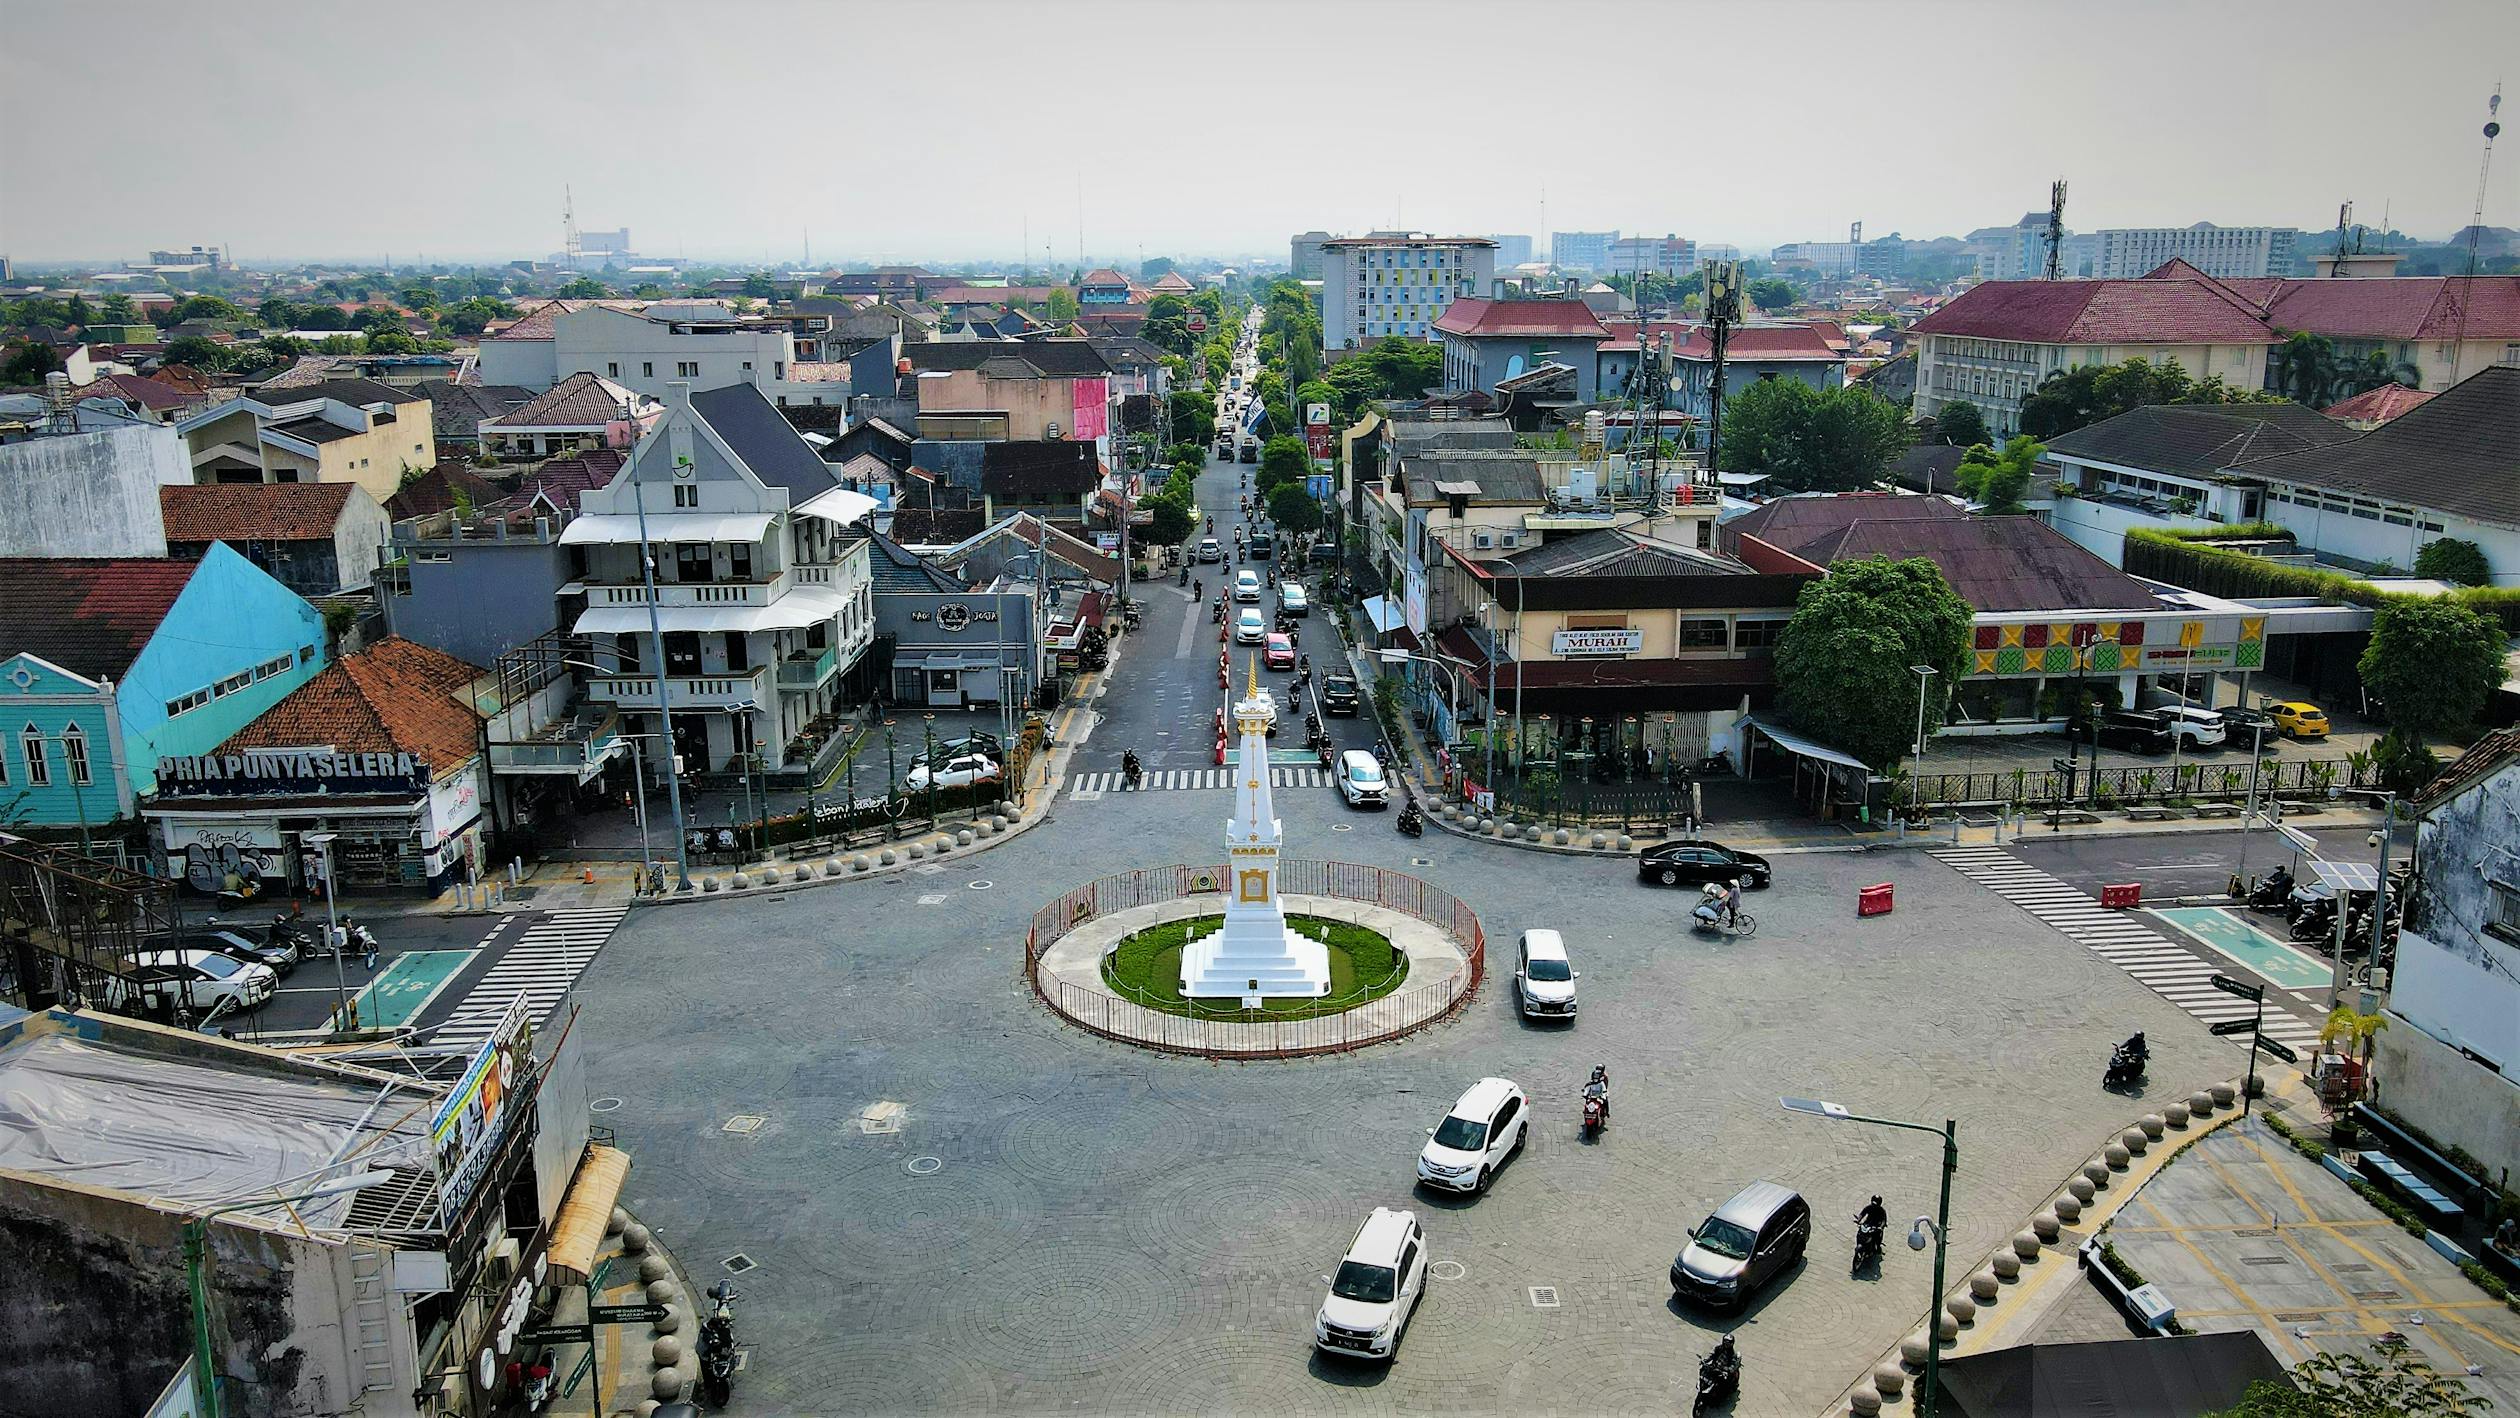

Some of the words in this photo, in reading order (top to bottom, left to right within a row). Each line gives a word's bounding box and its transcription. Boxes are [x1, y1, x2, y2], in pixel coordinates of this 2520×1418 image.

[1568, 637, 1628, 648] MURAH
[158, 756, 221, 780] PRIA
[225, 753, 315, 779] PUNYA
[315, 752, 415, 777] SELERA
